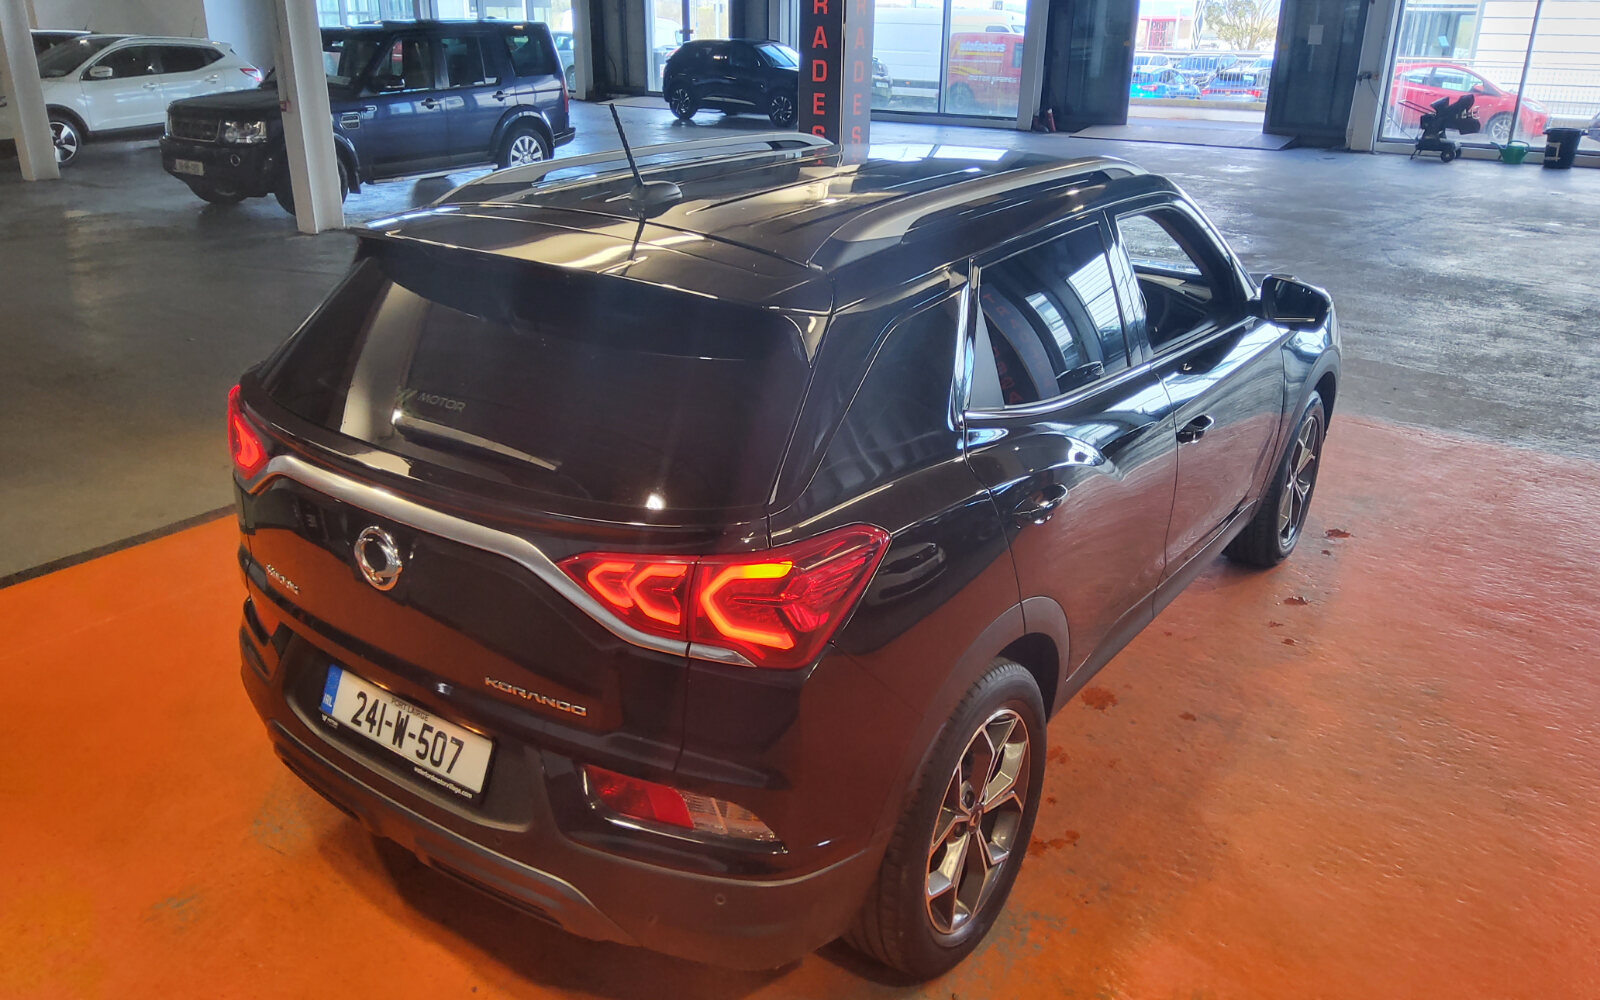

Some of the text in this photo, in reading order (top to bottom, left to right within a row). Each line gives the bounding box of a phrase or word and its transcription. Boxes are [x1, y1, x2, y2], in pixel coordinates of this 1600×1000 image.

[418, 392, 466, 412] MOTOR
[322, 693, 333, 708] IRL
[484, 676, 587, 717] KORANDO
